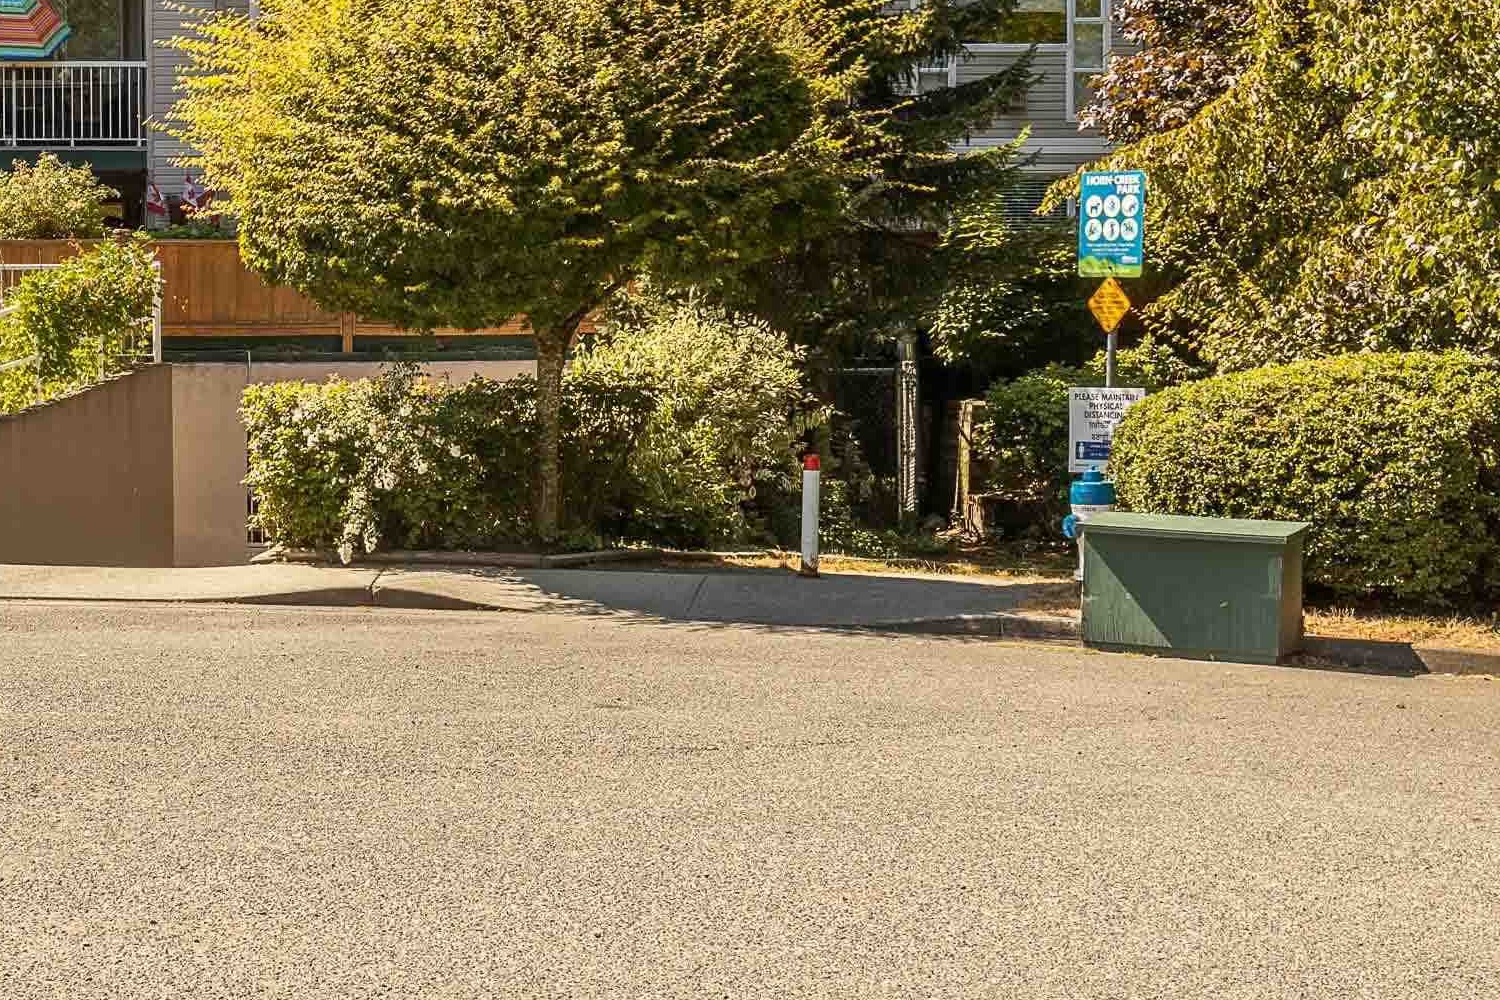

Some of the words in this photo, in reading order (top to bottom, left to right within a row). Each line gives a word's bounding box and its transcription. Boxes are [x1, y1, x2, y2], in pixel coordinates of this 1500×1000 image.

[1116, 184, 1141, 194] PARK
[1074, 393, 1099, 401] PLEASE
[1101, 393, 1140, 401] MAINTAIN
[1084, 411, 1126, 419] DISTANCIN
